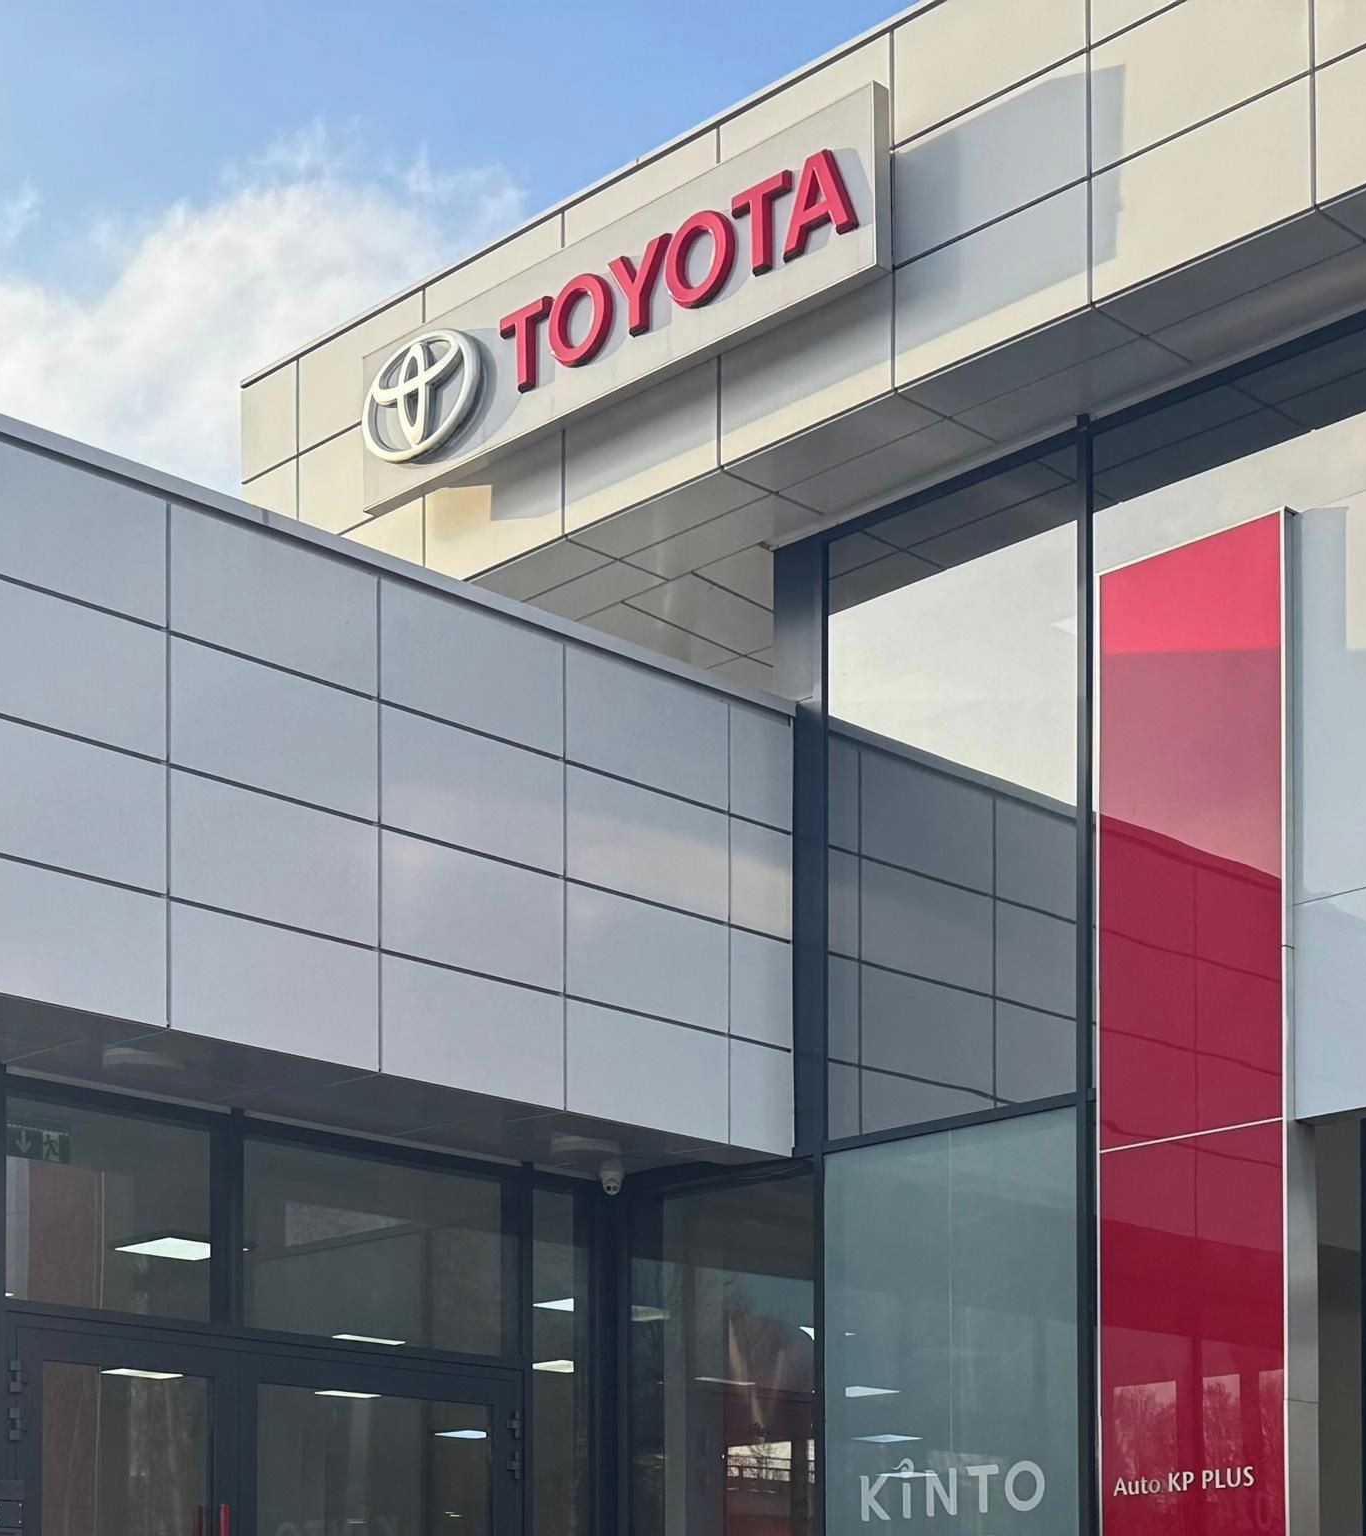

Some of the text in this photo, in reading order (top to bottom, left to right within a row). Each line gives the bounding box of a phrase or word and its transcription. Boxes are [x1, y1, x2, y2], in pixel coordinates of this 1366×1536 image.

[499, 149, 859, 393] TOYOTA
[1114, 1466, 1255, 1496] Auto KP PLUS
